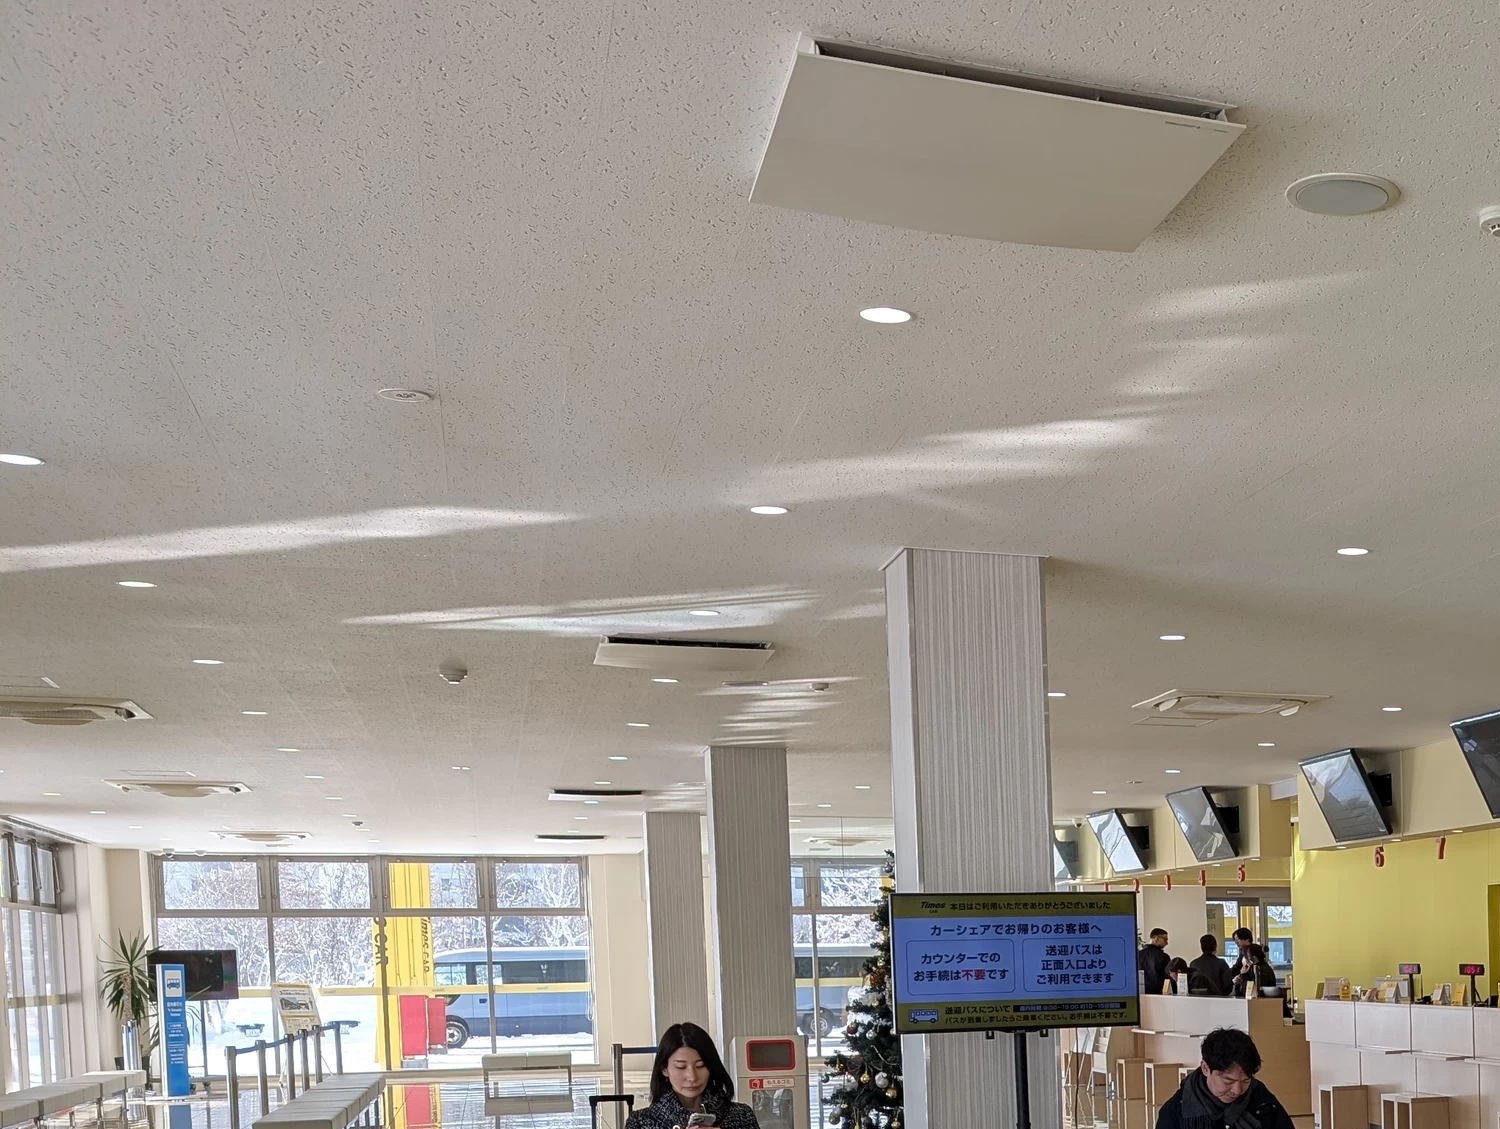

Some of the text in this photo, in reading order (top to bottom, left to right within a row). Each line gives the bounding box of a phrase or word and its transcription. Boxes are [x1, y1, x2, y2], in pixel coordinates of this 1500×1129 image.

[1436, 836, 1446, 860] 7
[1374, 846, 1385, 867] 6
[1237, 864, 1246, 882] 5
[920, 901, 946, 909] Times
[950, 901, 1110, 911] 本日はご利用いただきありがとうございました
[930, 923, 1102, 936] カーシェアでお帰りのお客様へ
[1045, 944, 1103, 956] 送迎バスは
[921, 952, 1001, 965] カウンターでの
[1041, 958, 1107, 971] 正面入口より
[913, 968, 1009, 982] お手続は不要です
[1463, 966, 1481, 974] 1051
[1036, 973, 1114, 985] ご利用できます
[945, 1005, 1011, 1014] 送迎バスについて
